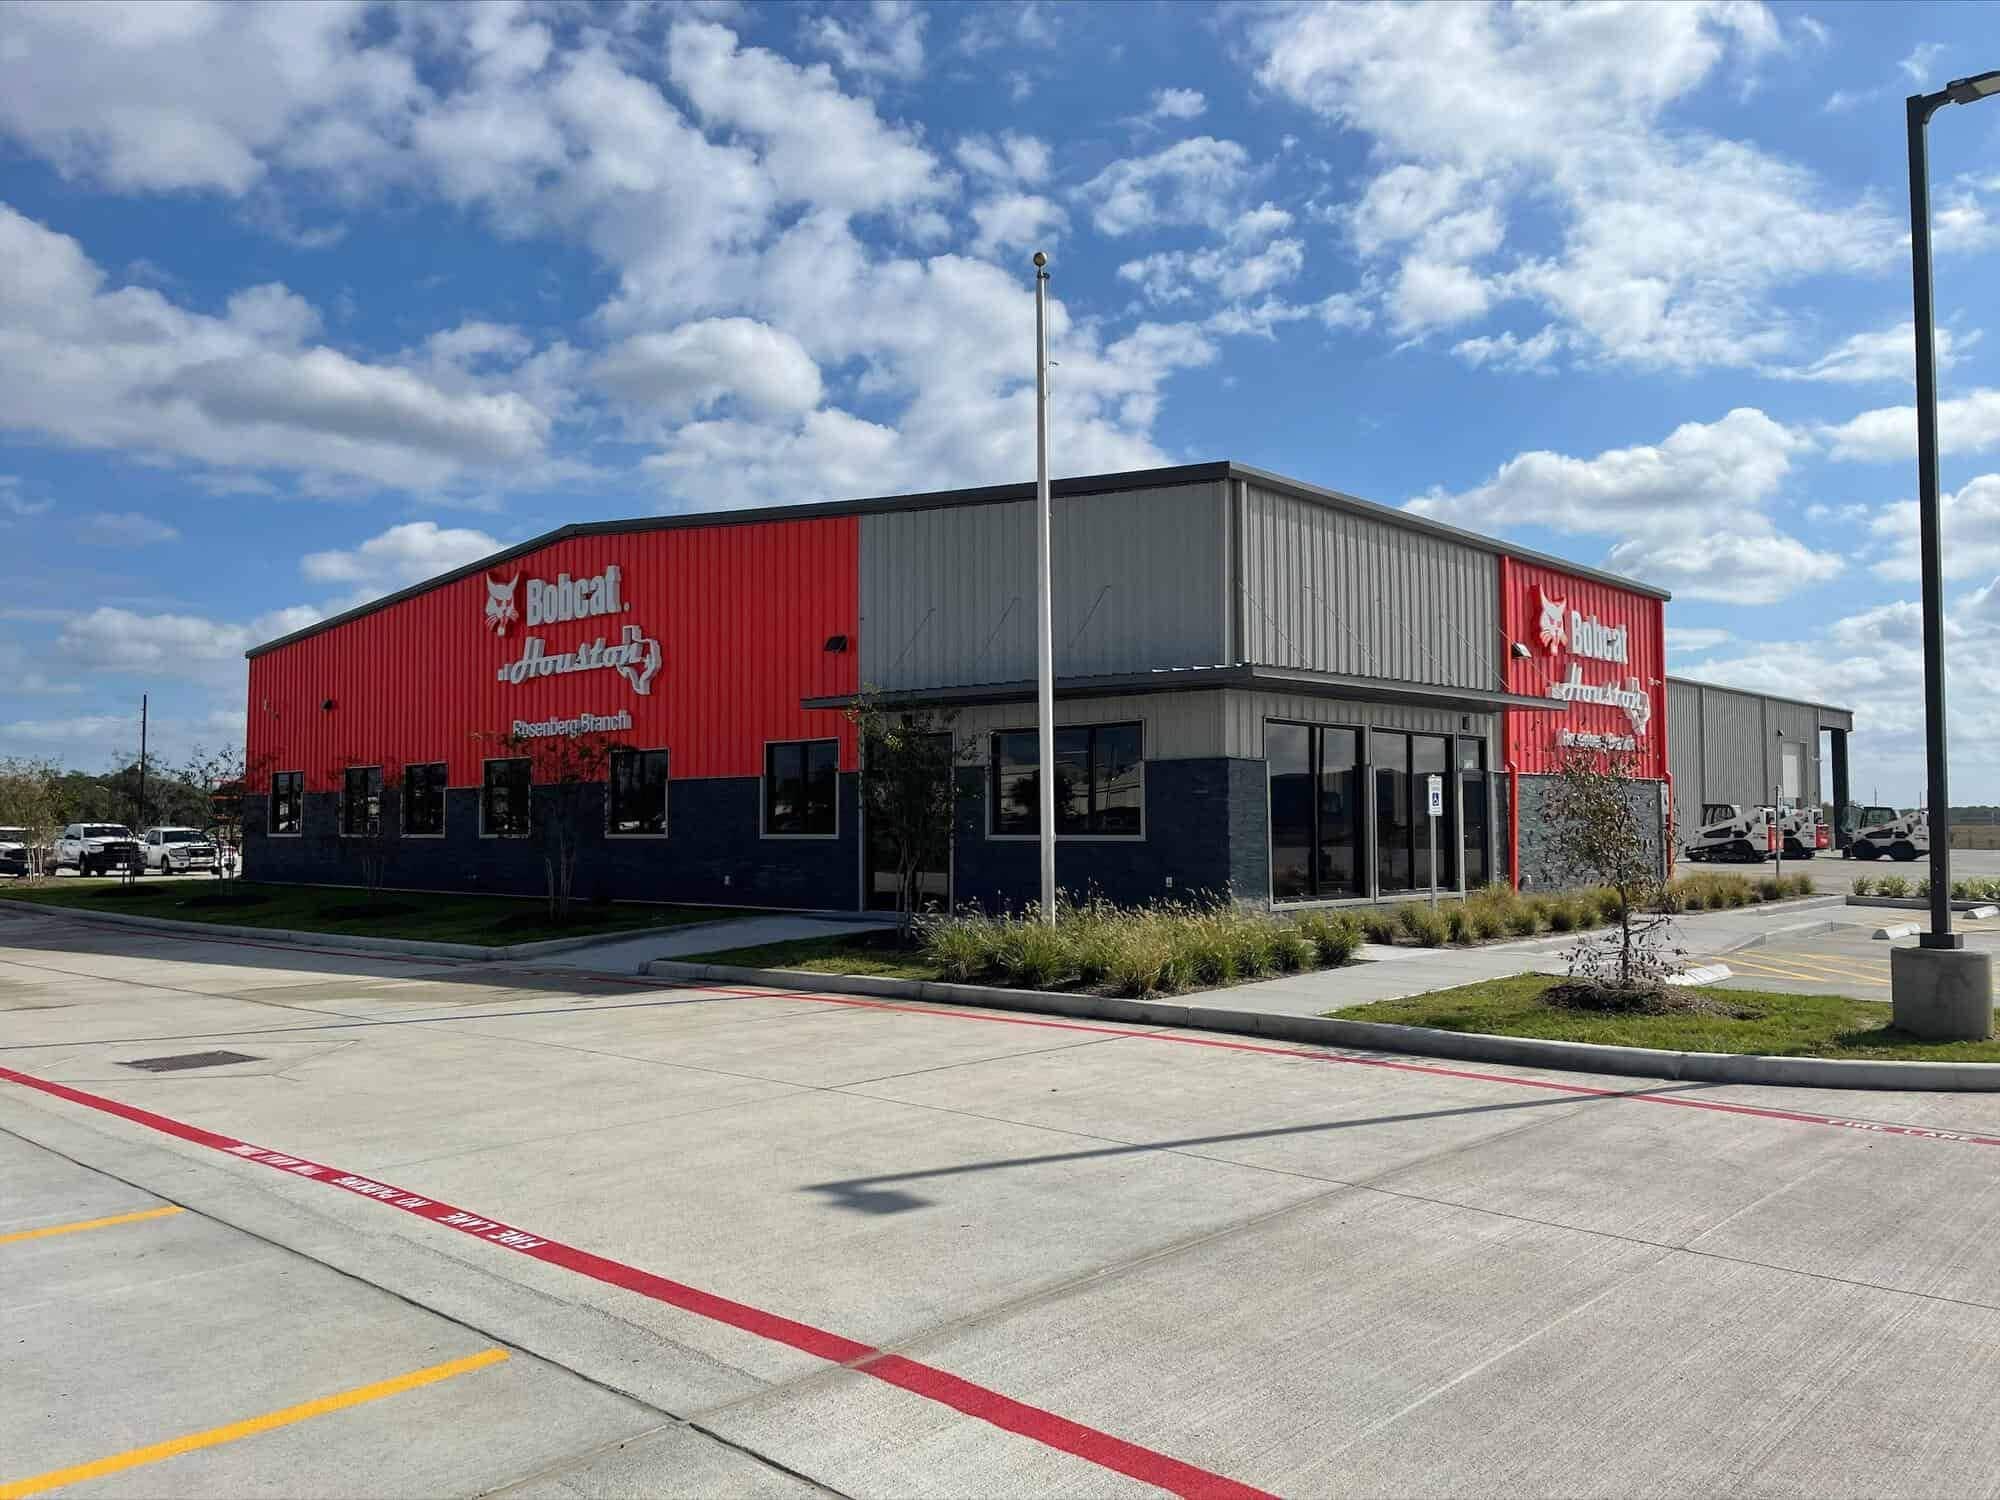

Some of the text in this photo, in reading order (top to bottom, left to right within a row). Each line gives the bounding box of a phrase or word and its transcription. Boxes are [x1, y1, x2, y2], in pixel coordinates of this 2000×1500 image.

[527, 566, 621, 626] Bobcat
[1571, 611, 1628, 664] Bobcat
[511, 637, 643, 683] Houston
[580, 709, 632, 733] Branch
[393, 1197, 433, 1209] NO
[436, 1212, 547, 1249] FIRE LANE
